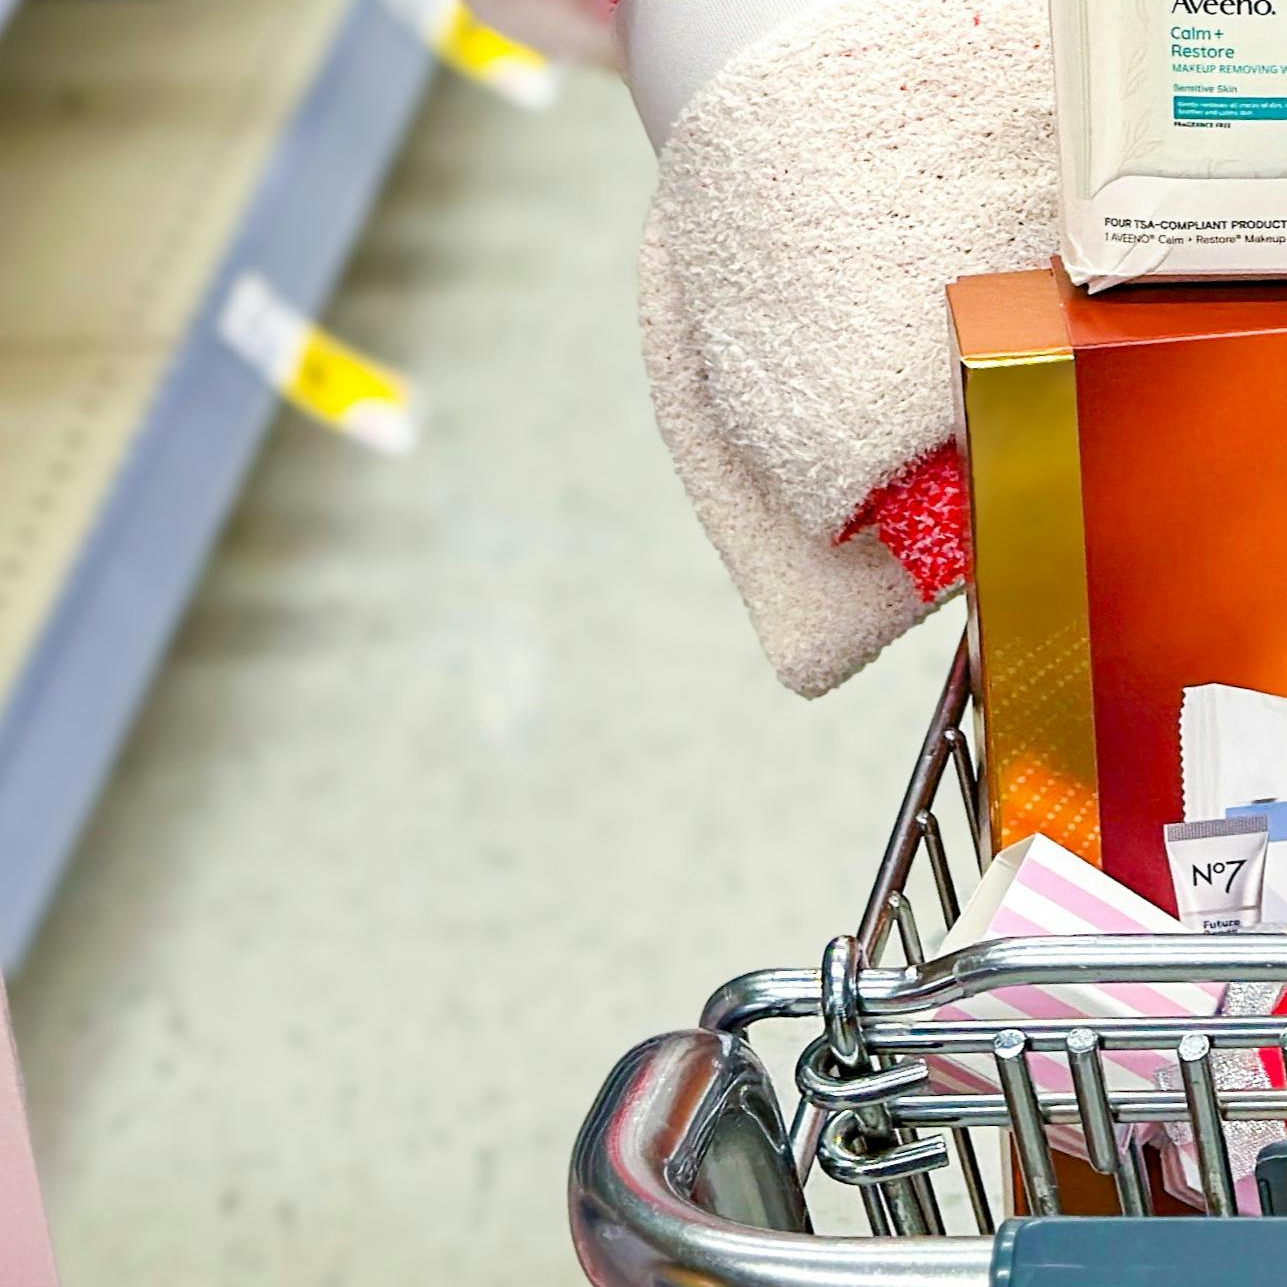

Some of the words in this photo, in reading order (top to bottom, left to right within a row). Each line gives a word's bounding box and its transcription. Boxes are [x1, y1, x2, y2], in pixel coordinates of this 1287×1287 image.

[1171, 26, 1212, 40] Calm
[1171, 44, 1235, 58] Restore
[1172, 63, 1216, 74] MAKEUP
[1219, 64, 1278, 74] REMOVING
[1173, 84, 1214, 93] Sensitive
[1217, 84, 1238, 93] Skin
[1105, 217, 1132, 228] FOUR
[1134, 219, 1227, 230] TSA-COMPLIANT
[1203, 919, 1241, 929] Future
